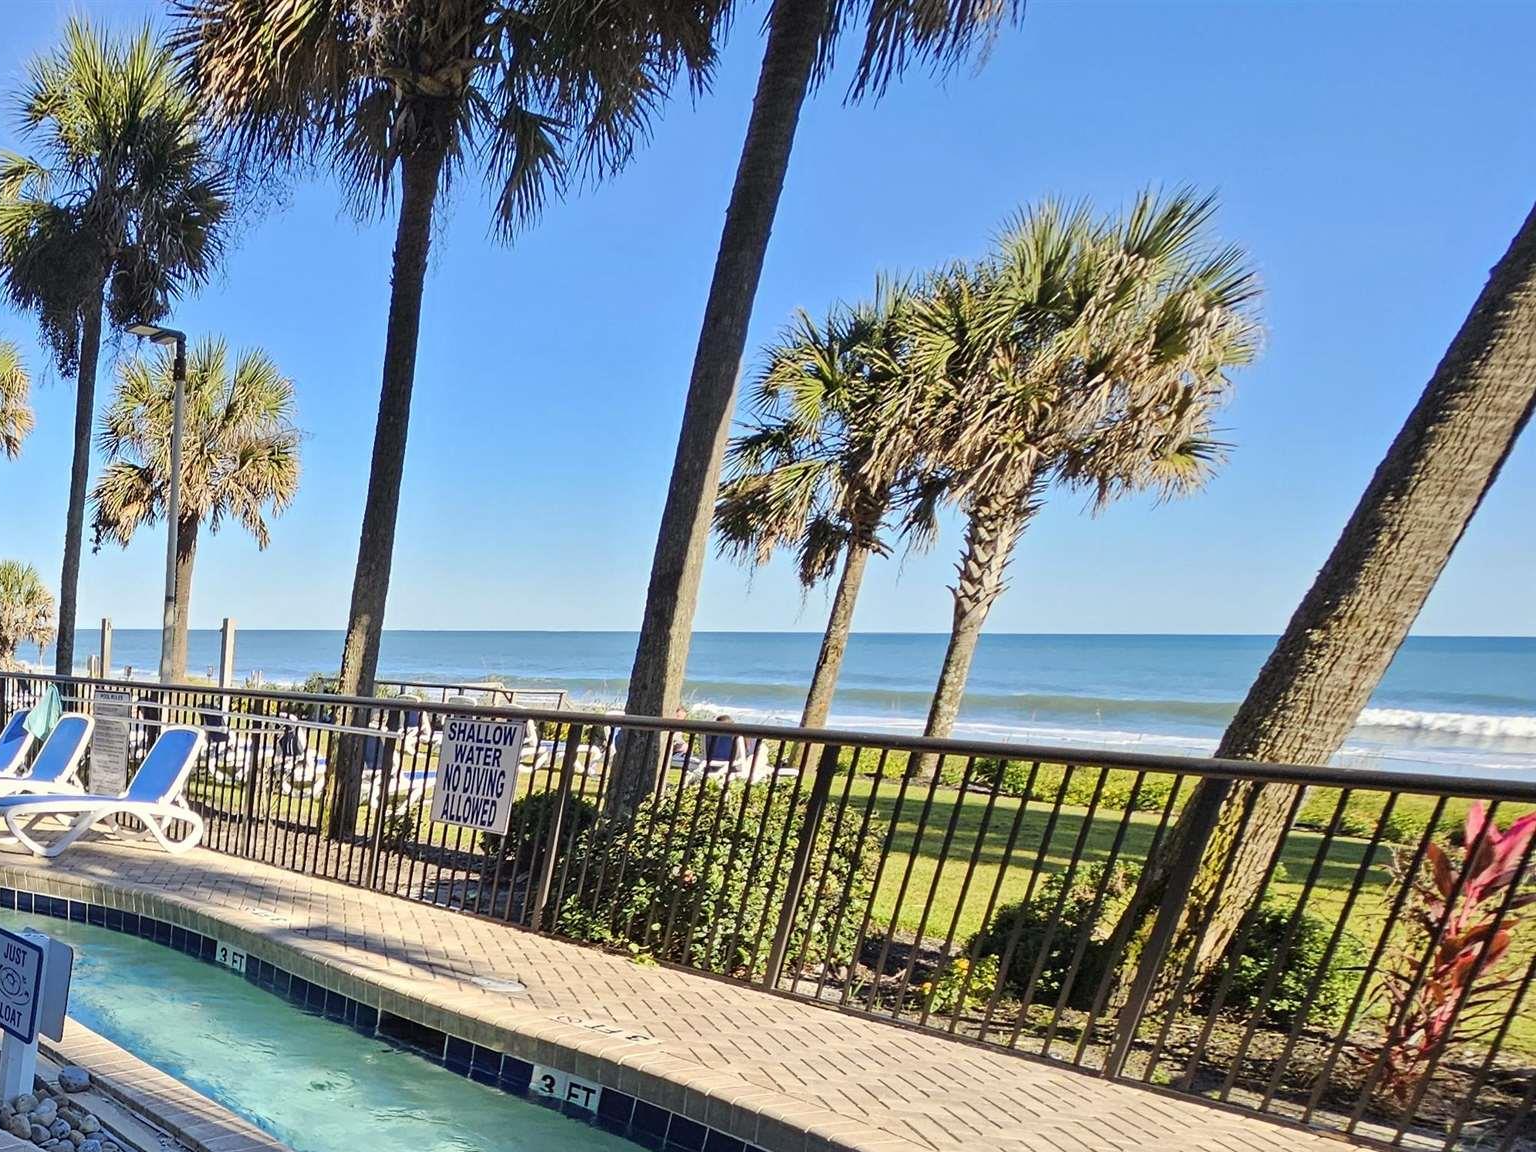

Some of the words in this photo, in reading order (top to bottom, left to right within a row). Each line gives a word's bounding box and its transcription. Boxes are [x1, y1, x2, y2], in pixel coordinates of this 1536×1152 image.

[448, 722, 516, 746] SHALLOW
[454, 744, 502, 767] WATER
[443, 764, 461, 792] NO
[463, 767, 506, 798] DIVING
[441, 793, 497, 827] ALLOWED
[4, 943, 27, 967] JUST
[220, 947, 228, 961] 3
[232, 952, 244, 971] FT
[540, 1074, 556, 1094] 3
[567, 1082, 596, 1107] FT
